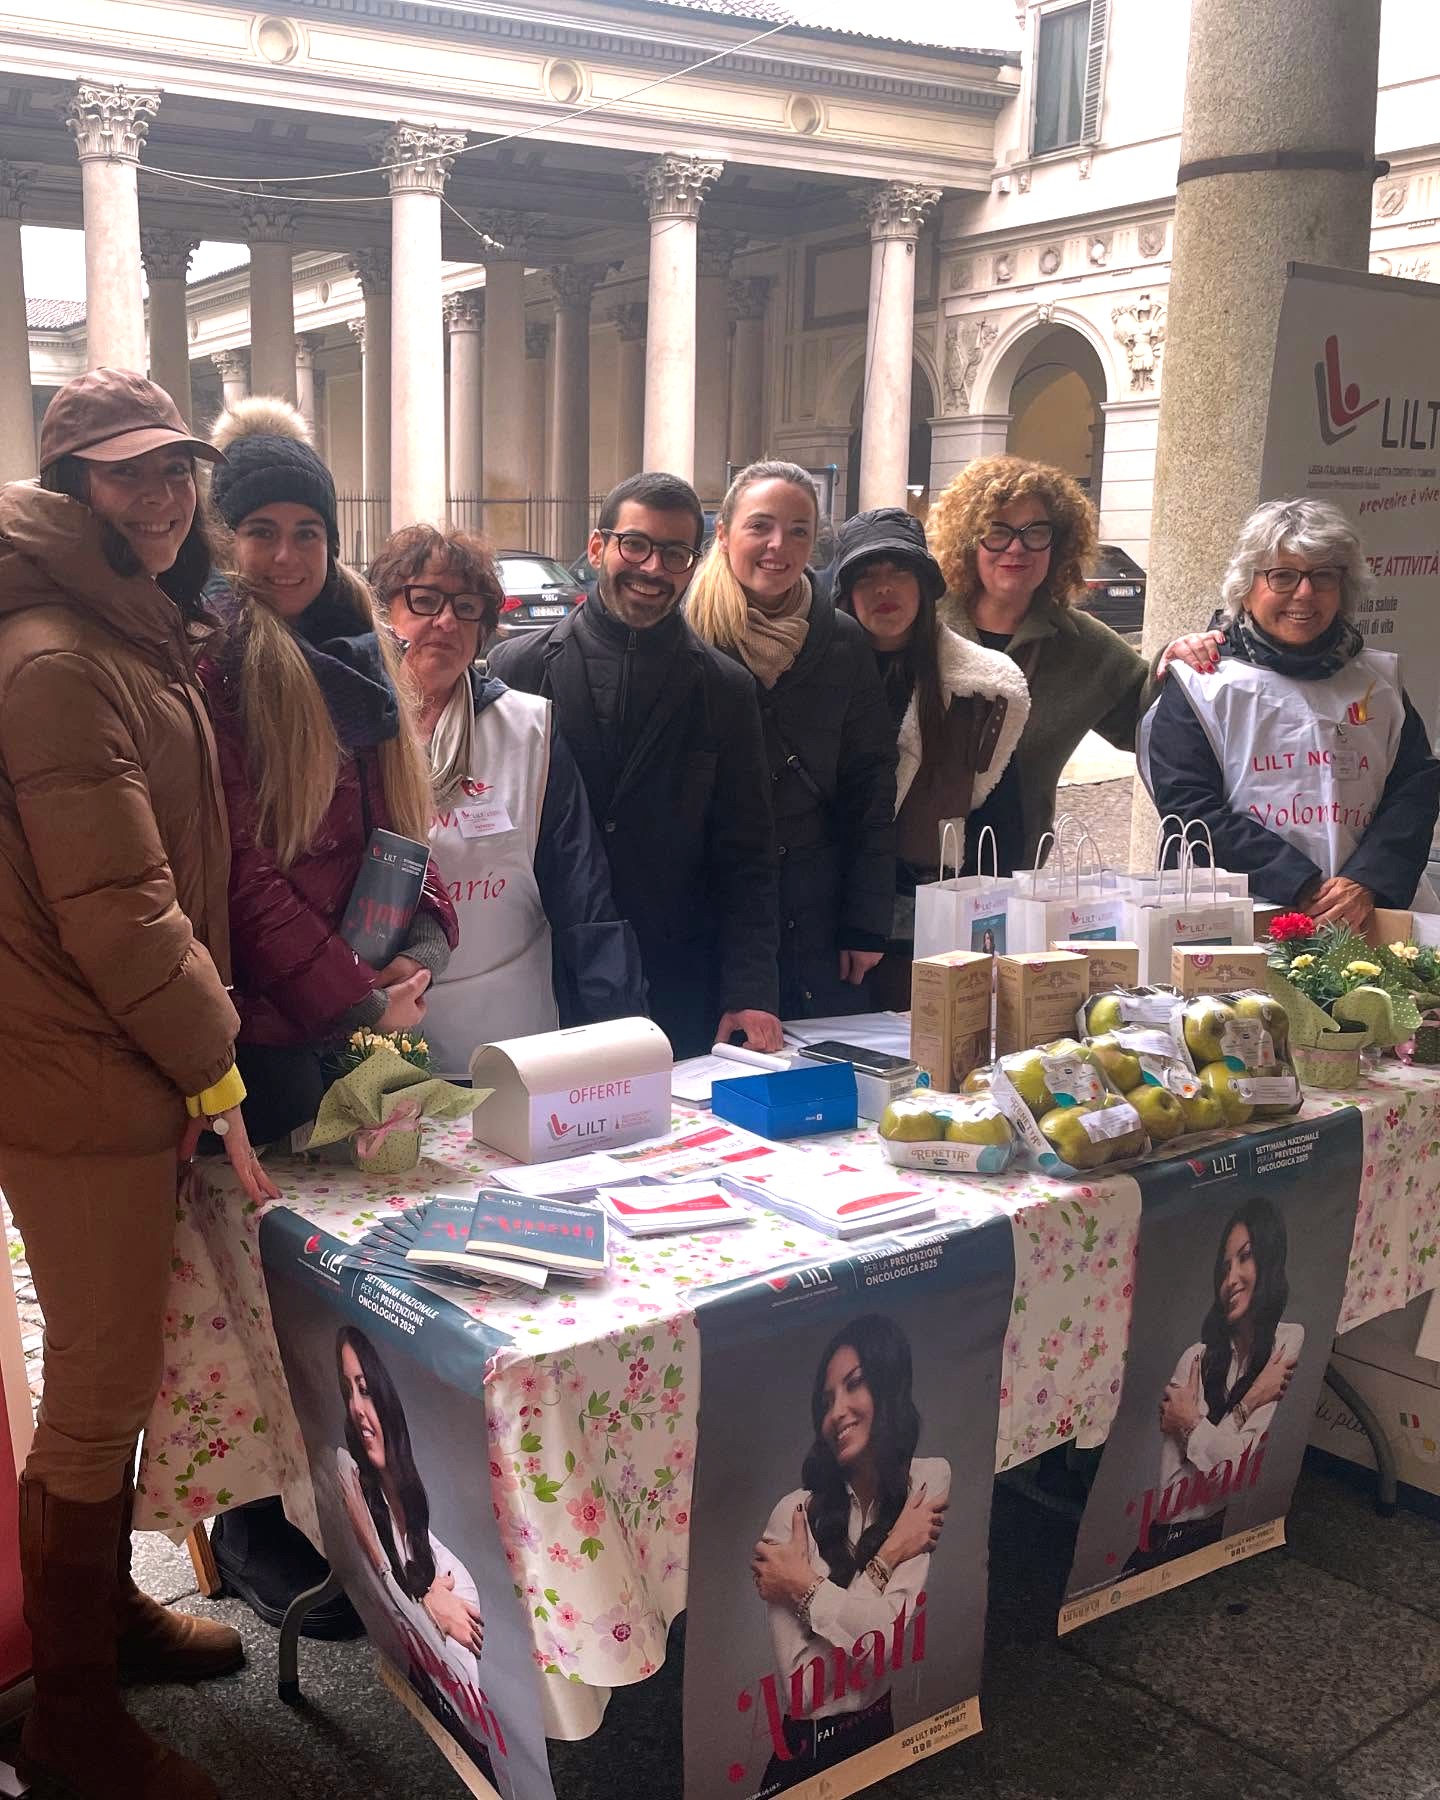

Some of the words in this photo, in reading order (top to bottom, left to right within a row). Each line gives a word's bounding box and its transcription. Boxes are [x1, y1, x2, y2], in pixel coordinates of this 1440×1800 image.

[1381, 397, 1440, 449] LILT
[1360, 491, 1407, 515] prevenire
[1375, 596, 1398, 611] salute
[1380, 619, 1394, 633] vita
[1254, 753, 1295, 772] LILT
[569, 1080, 631, 1104] OFFERTE
[577, 1119, 607, 1136] LILT
[1256, 1139, 1287, 1155] SETTIMANA
[1287, 1131, 1320, 1147] NAZIONALE
[1212, 1154, 1237, 1174] LILT
[1257, 1157, 1296, 1174] ONCOLOGICA
[857, 1245, 905, 1264] SETTIMANA
[890, 1245, 943, 1267] PREVENZIONE
[796, 1264, 834, 1289] LILT
[865, 1264, 919, 1286] ONCOLOGICA
[919, 1258, 938, 1272] 2025
[360, 1282, 373, 1297] PER
[372, 1289, 381, 1300] LA
[380, 1293, 425, 1327] PREVENZIONE
[364, 1273, 401, 1299] SETTIMANA
[399, 1292, 440, 1320] NAZIONALE
[358, 1294, 399, 1327] ONCOLOGICA
[399, 1318, 416, 1336] 2025
[817, 1726, 835, 1743] FAI
[901, 1737, 914, 1749] SOS
[915, 1730, 928, 1742] LILT
